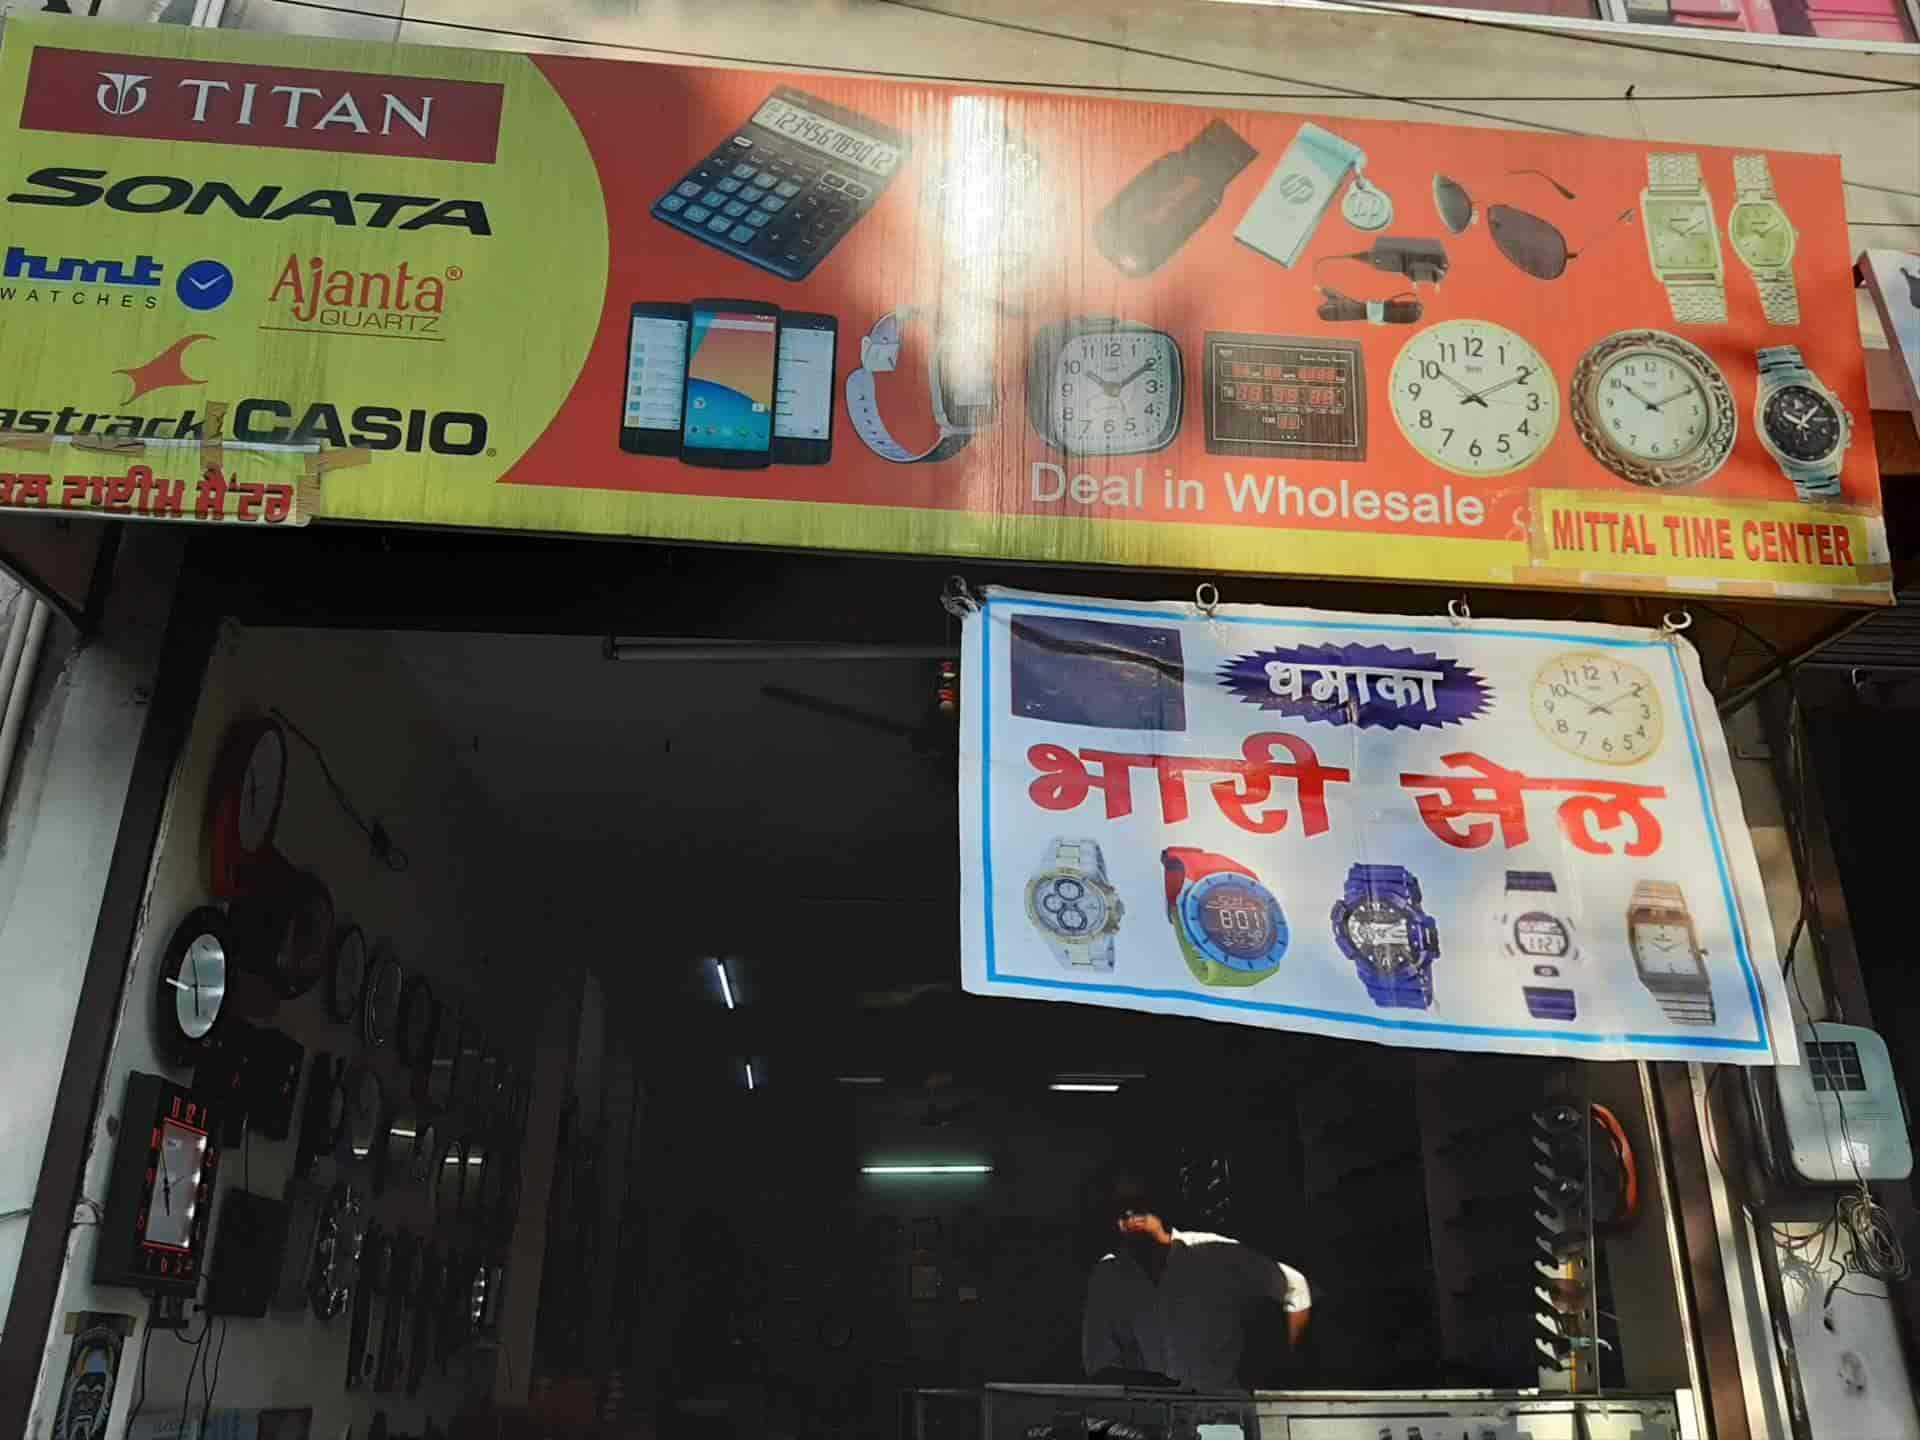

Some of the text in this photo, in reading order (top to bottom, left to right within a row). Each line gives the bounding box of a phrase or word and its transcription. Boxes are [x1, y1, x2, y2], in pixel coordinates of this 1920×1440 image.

[179, 78, 433, 139] TITAN
[7, 167, 493, 237] SONATA
[3, 246, 164, 287] hmt
[0, 287, 157, 309] WATCHES
[319, 309, 440, 333] QUARTZ
[1439, 343, 1456, 363] 11
[1464, 336, 1483, 358] 12
[1498, 345, 1505, 365] 1
[1418, 359, 1440, 380] 10
[1408, 382, 1422, 401] 9
[1526, 392, 1540, 411] 3
[233, 398, 488, 456] CASIO
[1419, 409, 1433, 429] 8
[1517, 418, 1529, 436] 4
[1440, 428, 1455, 447] 7
[1469, 438, 1482, 457] 6
[1496, 433, 1511, 453] 5
[1031, 462, 1144, 505] Deal
[1163, 468, 1205, 511] in
[1224, 472, 1485, 526] Wholesale
[1551, 509, 1657, 556] MITTAL
[1664, 515, 1735, 560] TIME
[1743, 519, 1855, 567] CENTER
[1265, 661, 1443, 711] धमाका
[1027, 731, 1666, 857] भारी सेल
